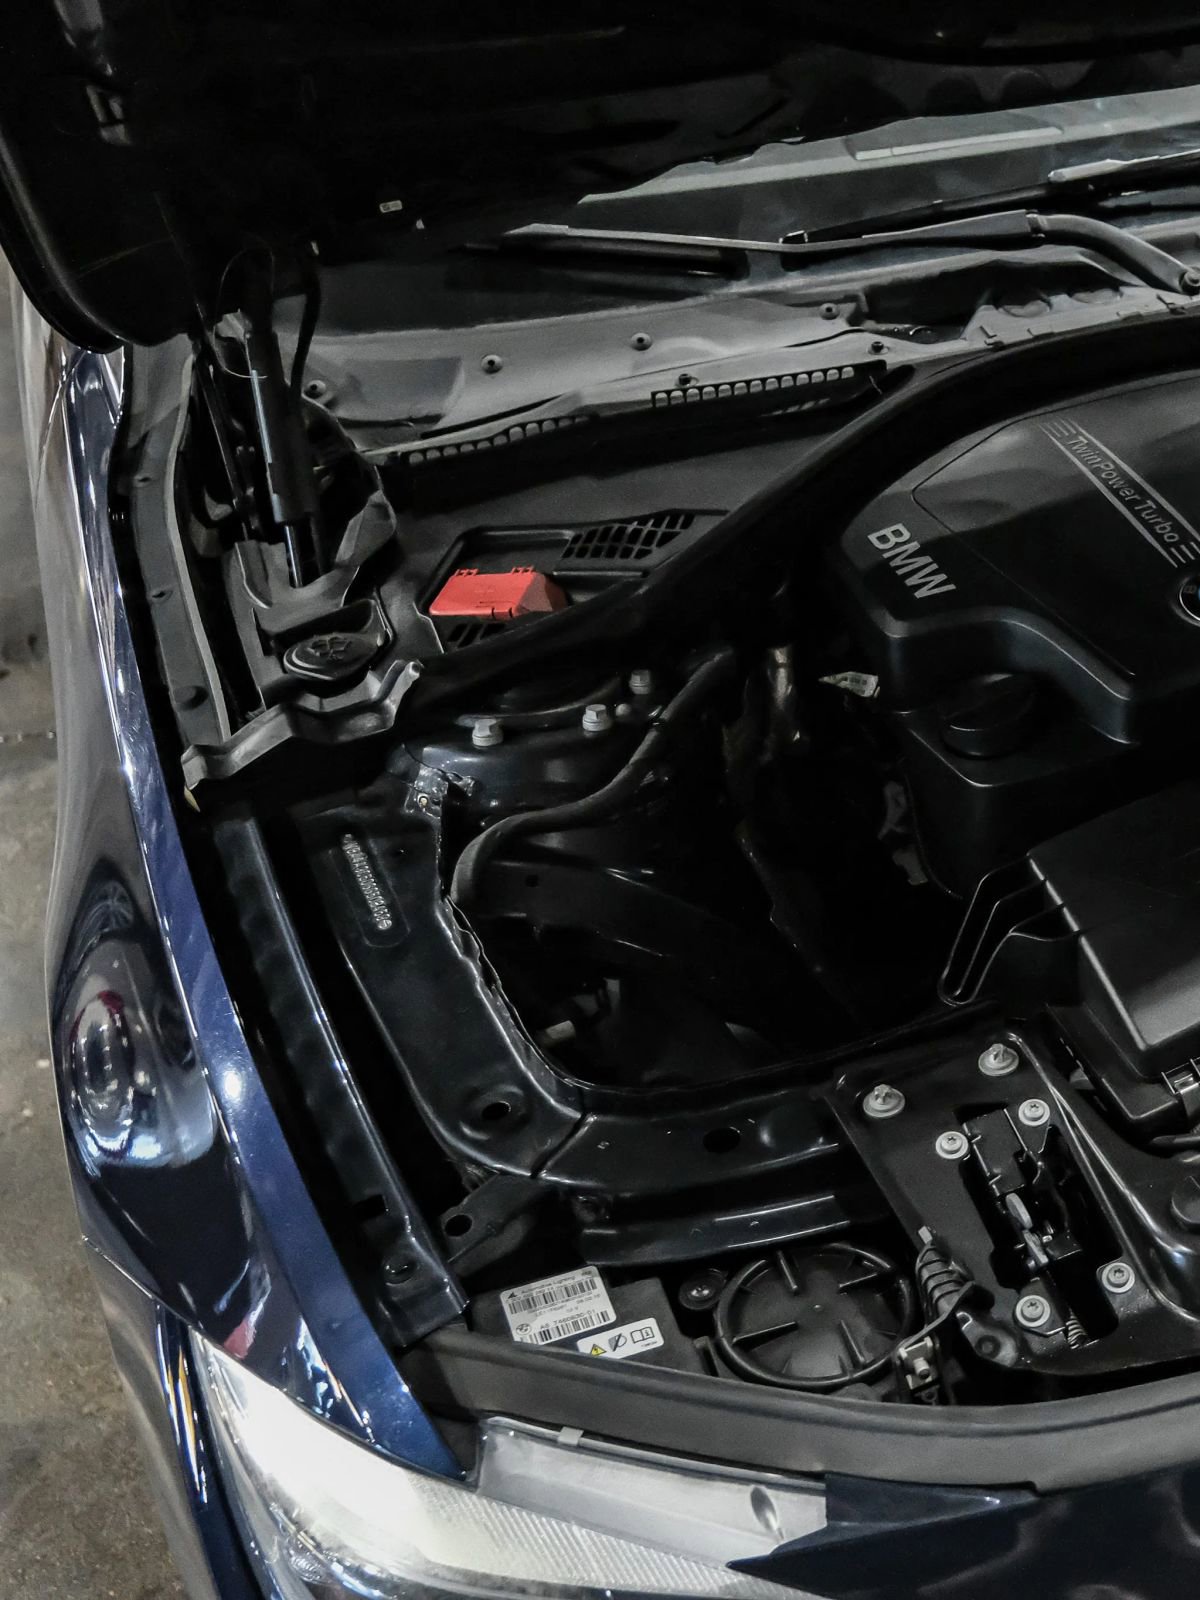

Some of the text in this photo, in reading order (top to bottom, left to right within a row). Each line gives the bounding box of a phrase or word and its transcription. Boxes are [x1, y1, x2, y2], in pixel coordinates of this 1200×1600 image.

[1068, 436, 1179, 543] TwinPower Turbo
[867, 522, 957, 599] BMW
